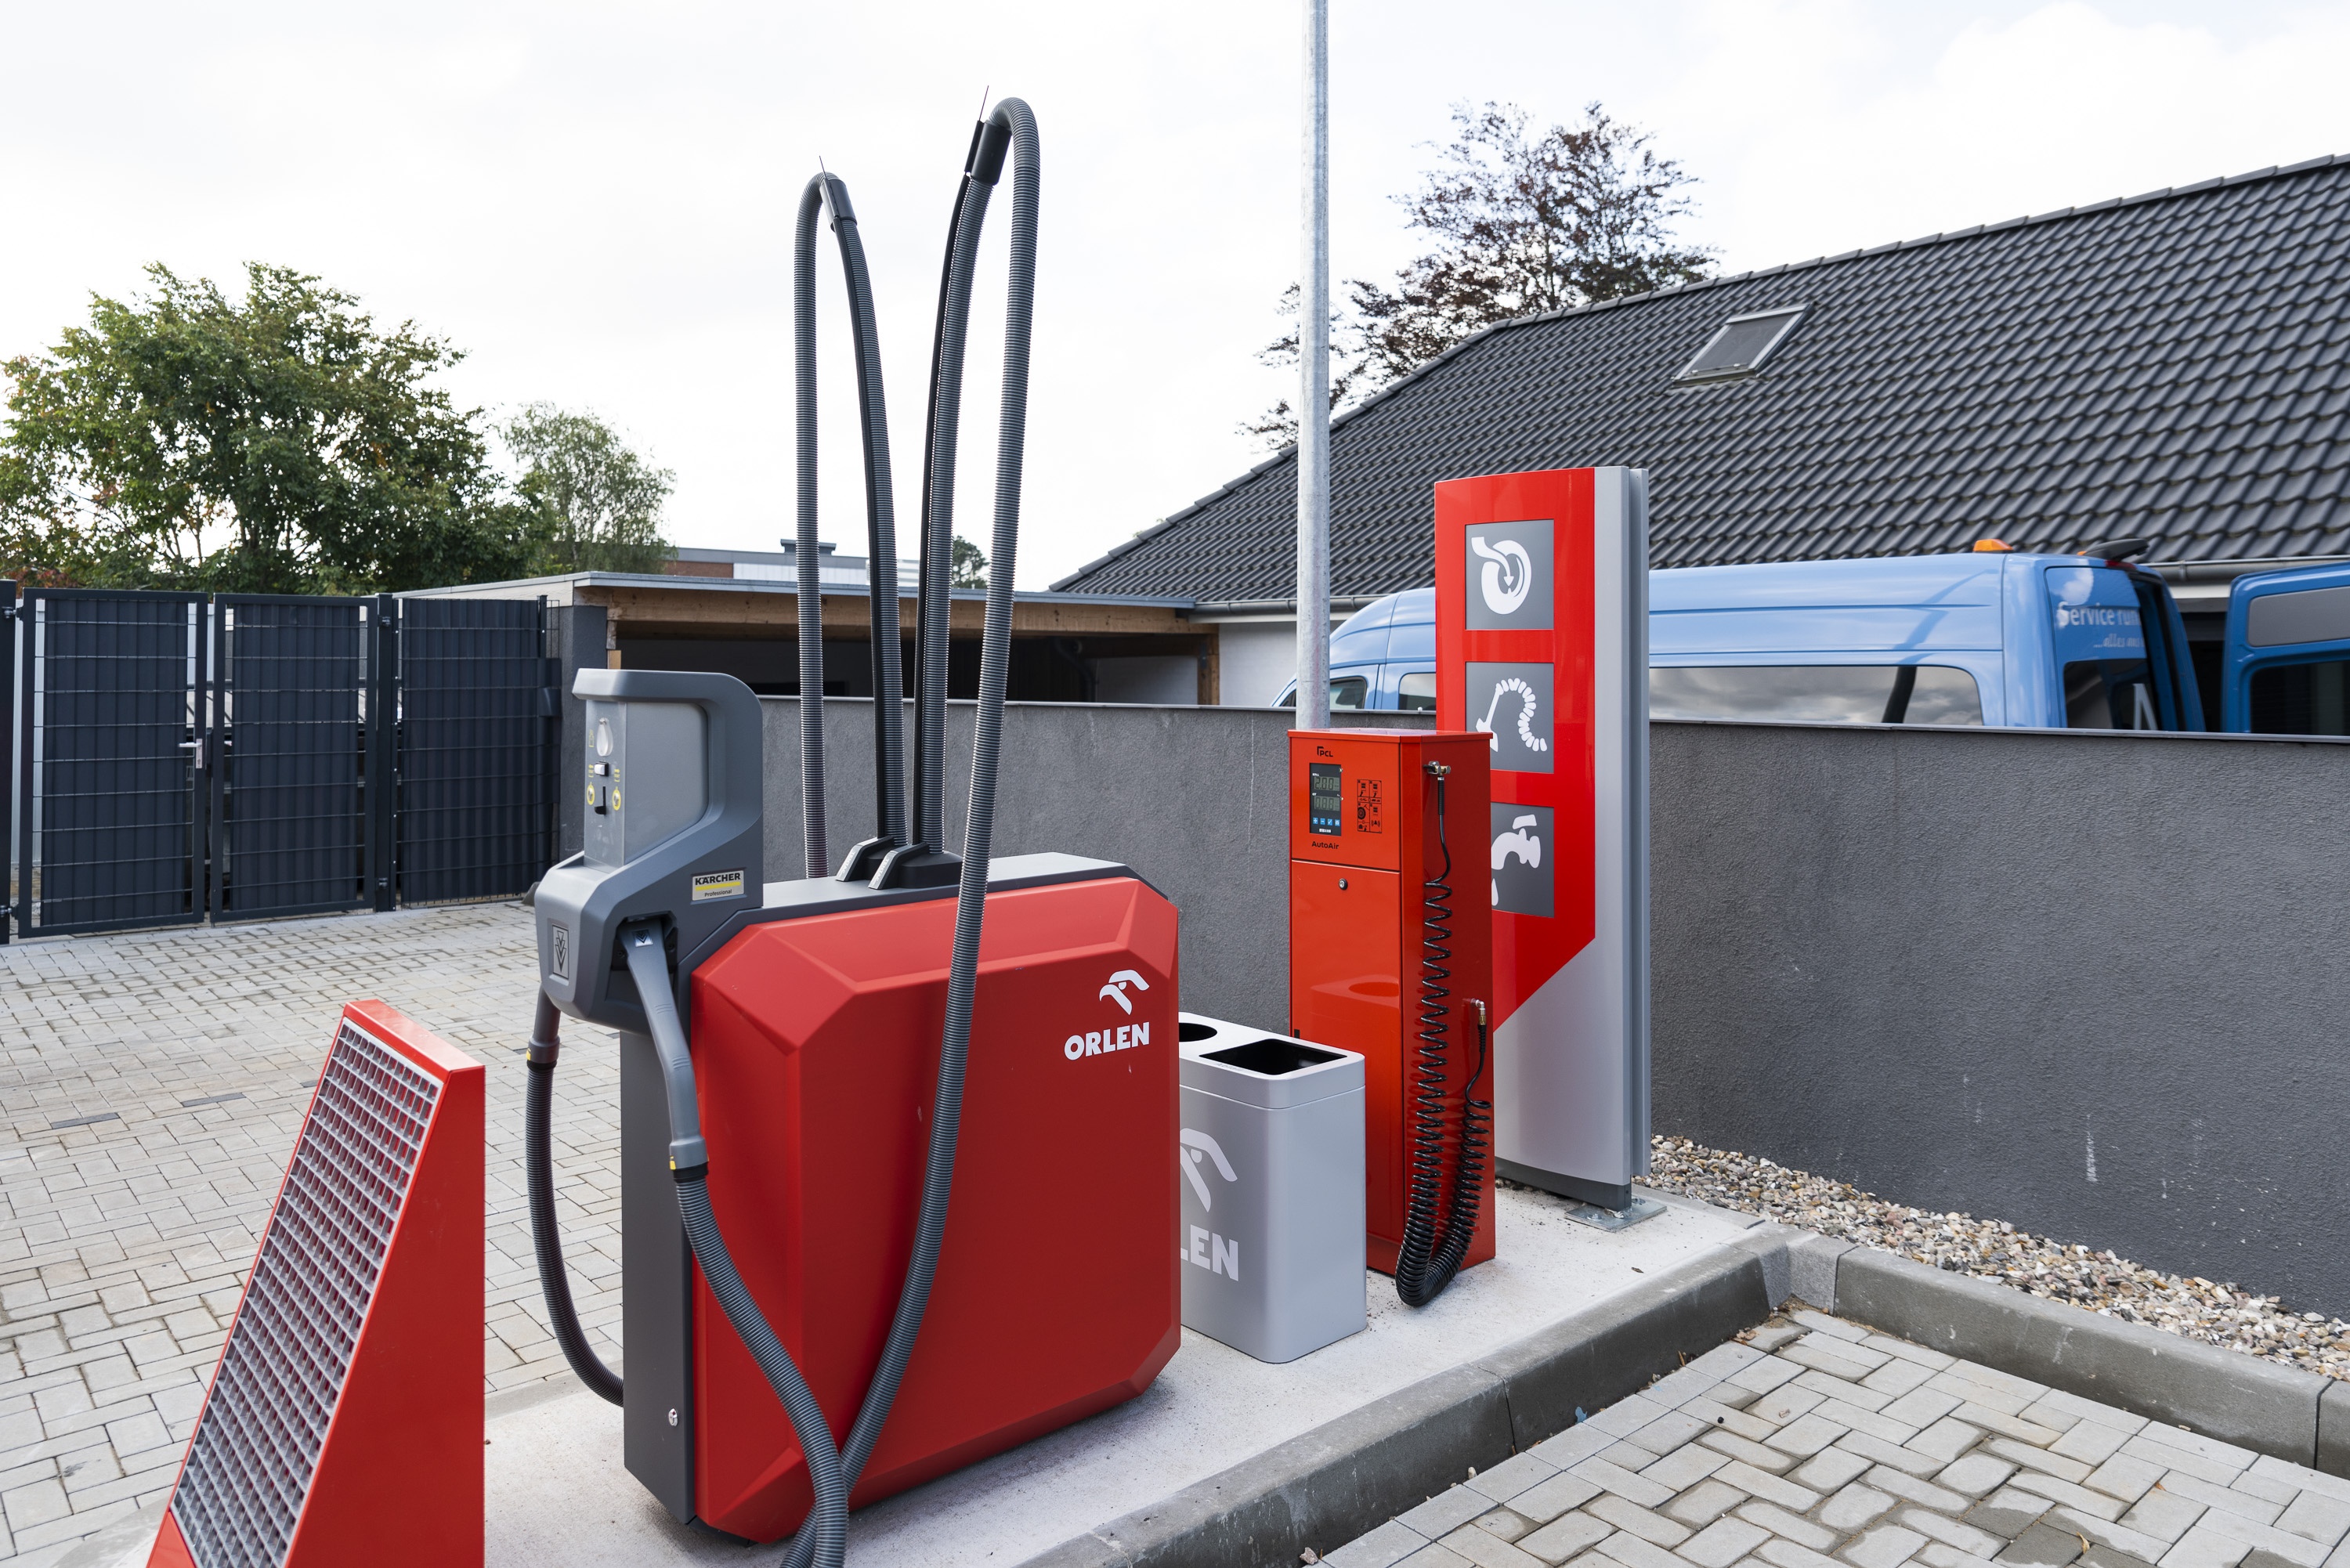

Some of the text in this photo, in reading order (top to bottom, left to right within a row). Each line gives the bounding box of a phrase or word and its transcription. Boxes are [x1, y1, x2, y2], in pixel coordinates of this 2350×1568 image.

[2057, 602, 2115, 627] Service
[1318, 748, 1334, 757] PCL
[1311, 840, 1340, 850] AutoAir
[695, 873, 741, 886] KÄRCHER
[704, 889, 732, 898] Professional
[1065, 1021, 1150, 1060] ORLEN
